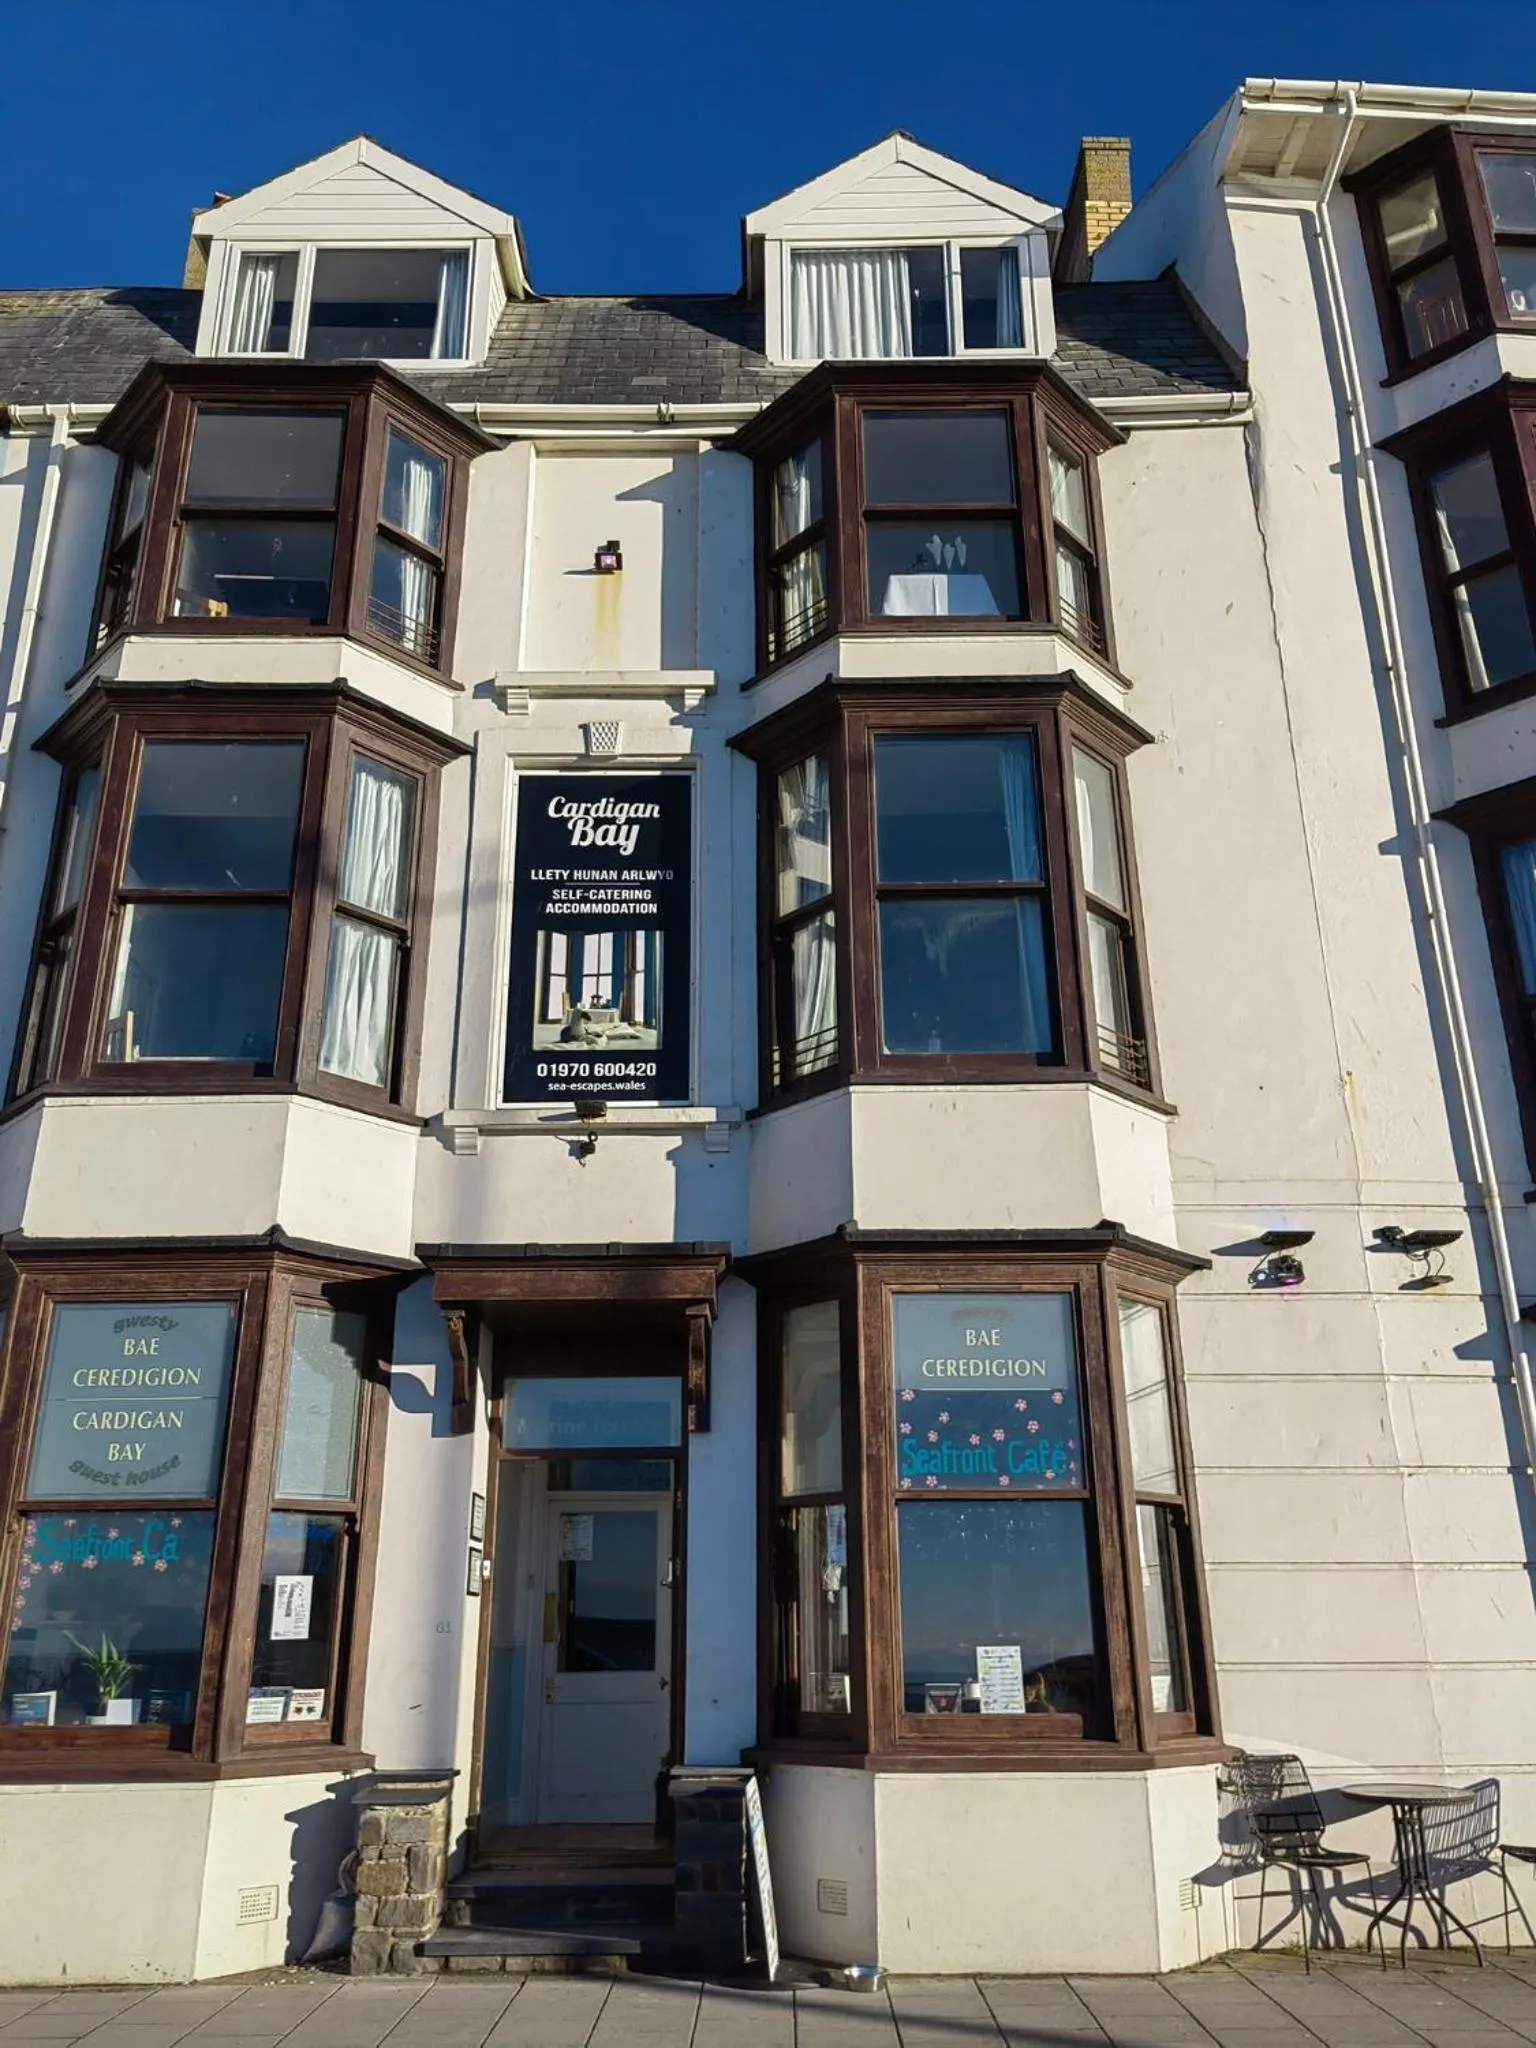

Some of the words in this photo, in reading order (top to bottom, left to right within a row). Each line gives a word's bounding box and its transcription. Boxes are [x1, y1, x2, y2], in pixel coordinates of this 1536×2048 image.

[548, 796, 660, 824] Cardigan
[567, 815, 640, 856] Bay
[530, 869, 570, 880] LLETY
[573, 869, 618, 880] HUNAN
[552, 889, 652, 900] SELF-CATERING
[545, 903, 658, 914] ACCOMMODATION
[537, 1063, 590, 1077] 01970
[593, 1063, 657, 1077] 600420
[548, 1080, 646, 1093] sea-escapes.wales
[113, 1315, 180, 1334] gwesty
[123, 1337, 160, 1356] BAE
[965, 1329, 1001, 1347] BAE
[73, 1367, 201, 1387] CEREDIGION
[922, 1359, 1046, 1377] CEREDIGION
[73, 1411, 184, 1431] CARDIGAN
[108, 1443, 147, 1462] BAY
[902, 1438, 997, 1477] Seafront
[68, 1459, 121, 1486] guest
[125, 1454, 182, 1486] house
[32, 1519, 133, 1563] Seafront
